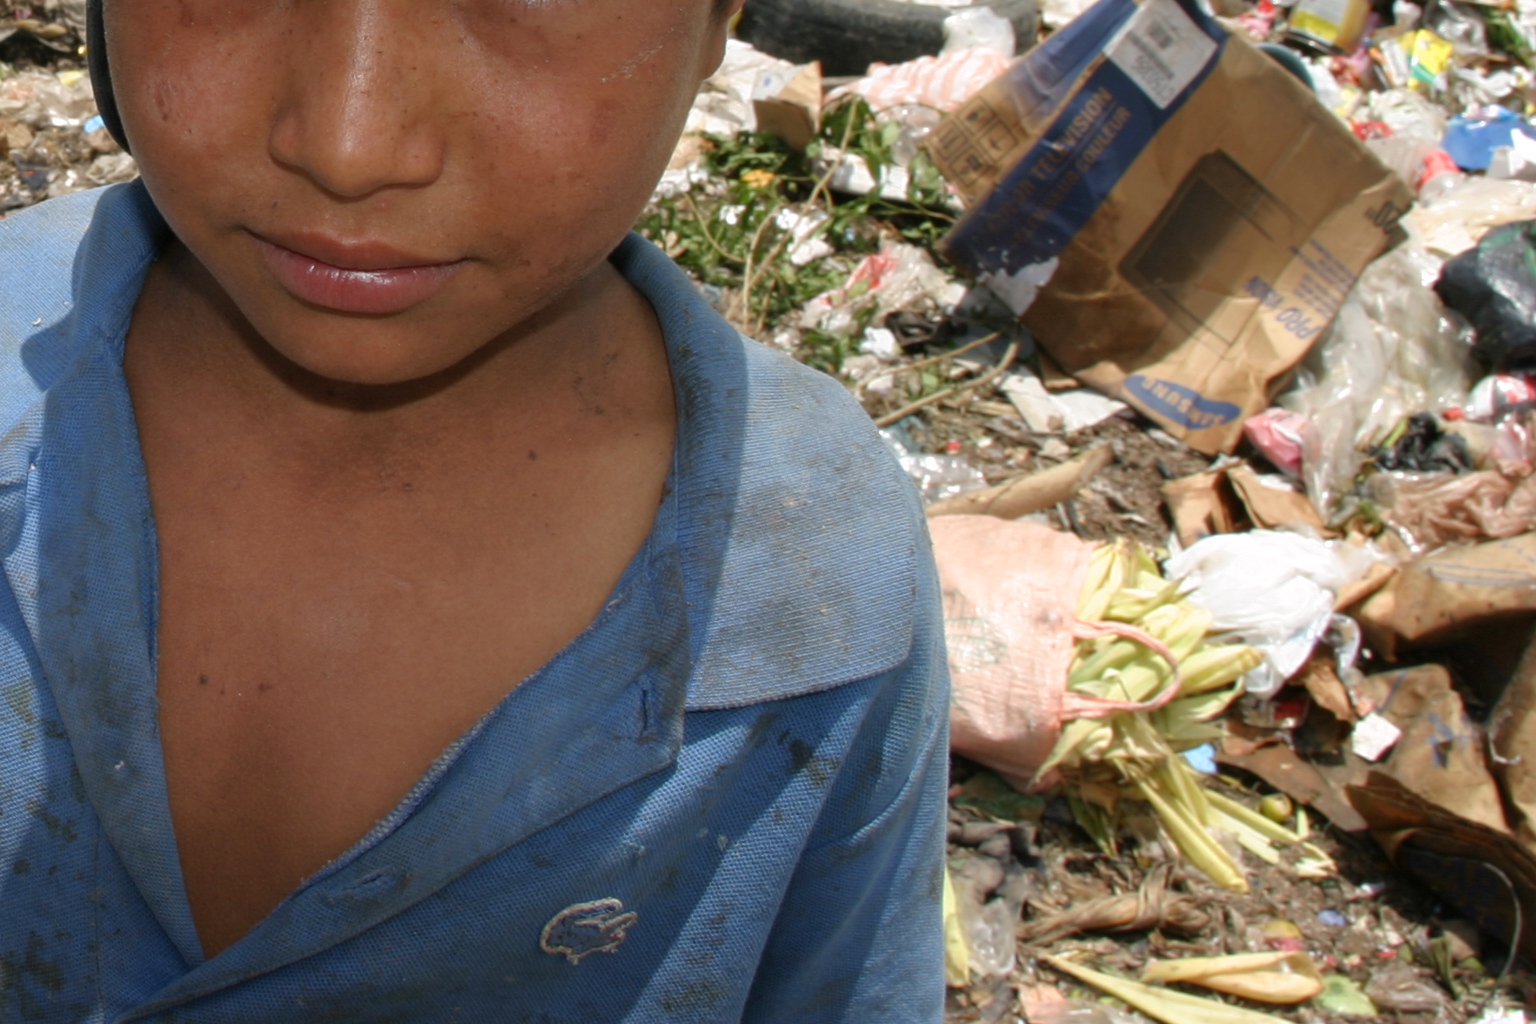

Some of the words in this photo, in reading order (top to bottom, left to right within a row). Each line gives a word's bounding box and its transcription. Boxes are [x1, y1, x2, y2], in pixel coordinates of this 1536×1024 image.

[1074, 106, 1132, 174] COULEUR
[1276, 306, 1322, 340] PRO
[1140, 377, 1227, 428] SAMSUNG
